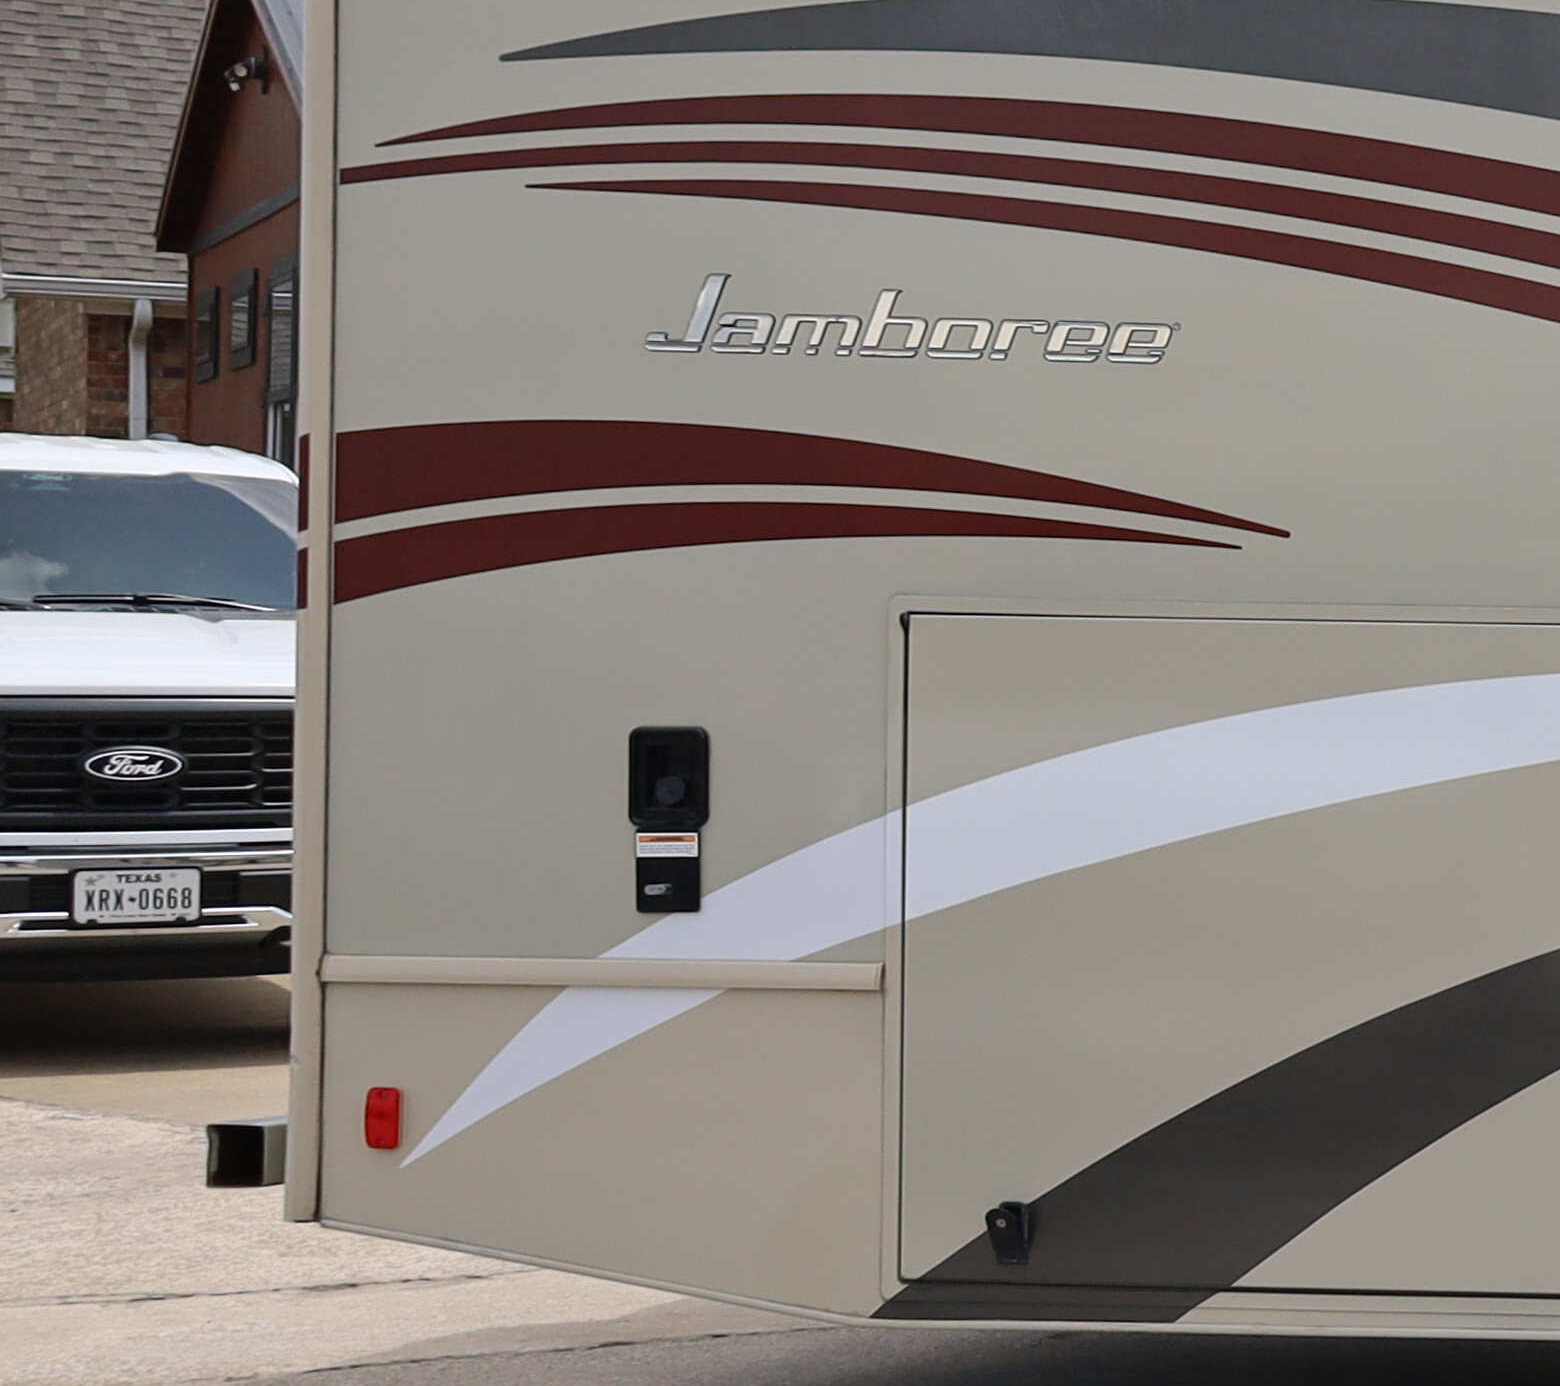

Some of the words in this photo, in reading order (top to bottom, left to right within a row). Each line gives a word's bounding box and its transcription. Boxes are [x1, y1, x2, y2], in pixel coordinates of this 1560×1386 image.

[645, 273, 1174, 363] Jamboree
[103, 754, 165, 776] Ford
[116, 873, 162, 884] TEXAS
